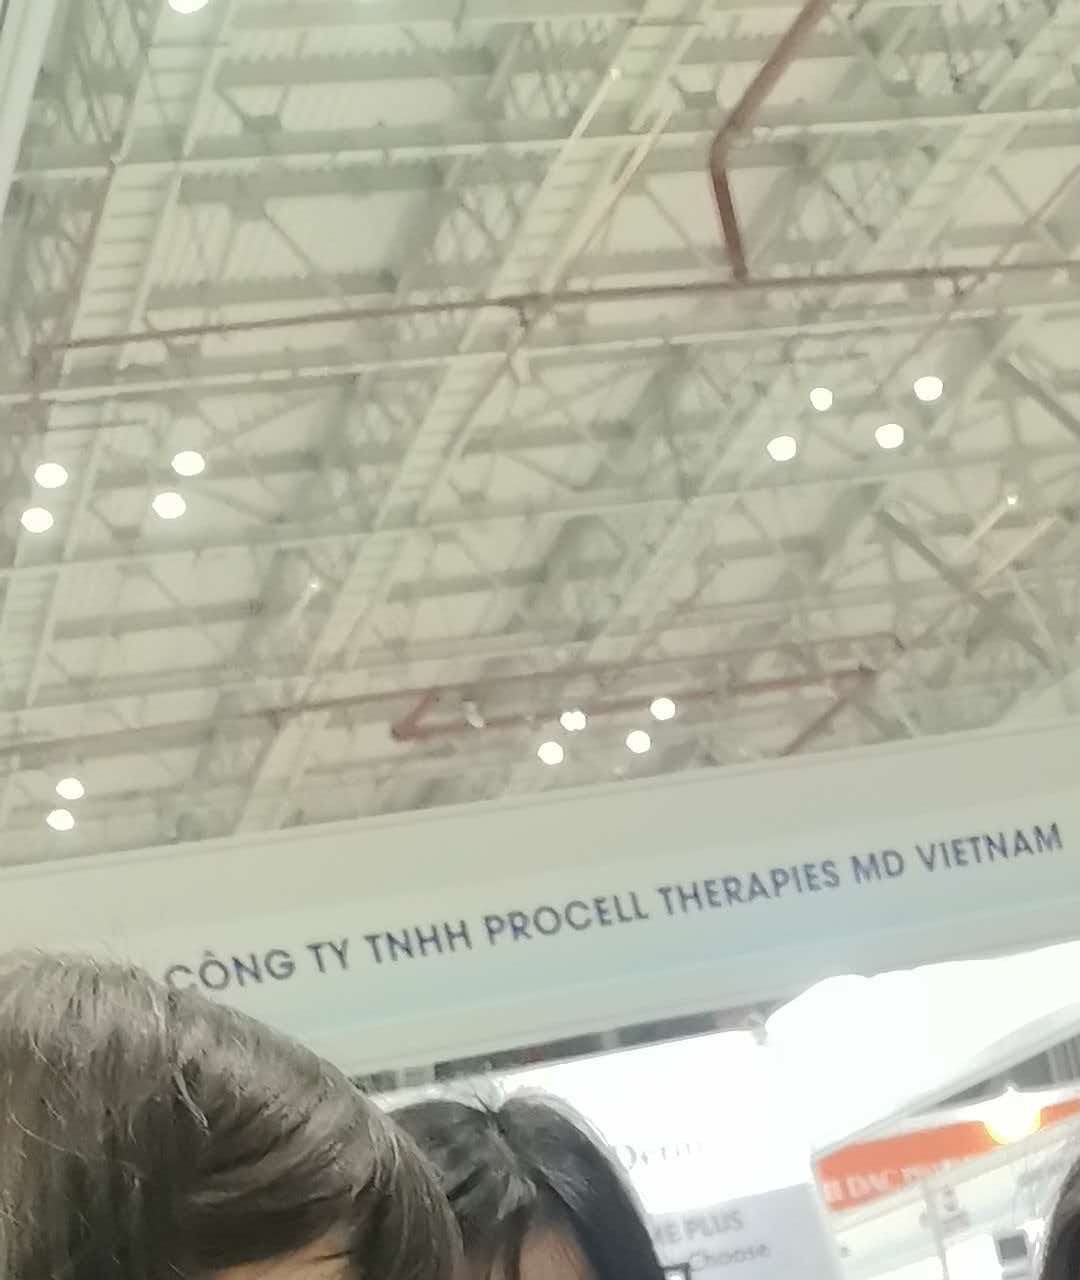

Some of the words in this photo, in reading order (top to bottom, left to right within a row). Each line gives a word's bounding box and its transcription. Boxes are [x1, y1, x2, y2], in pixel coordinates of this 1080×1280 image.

[165, 947, 296, 993] CÔNG
[307, 938, 351, 973] TY
[363, 919, 474, 965] TNHH
[481, 891, 650, 945] PROCELL
[658, 859, 840, 911] THERAPIES
[851, 849, 905, 886] MD
[915, 822, 1065, 874] VIETNAM
[683, 1209, 744, 1239] PLUS
[688, 1243, 771, 1271] Choose
